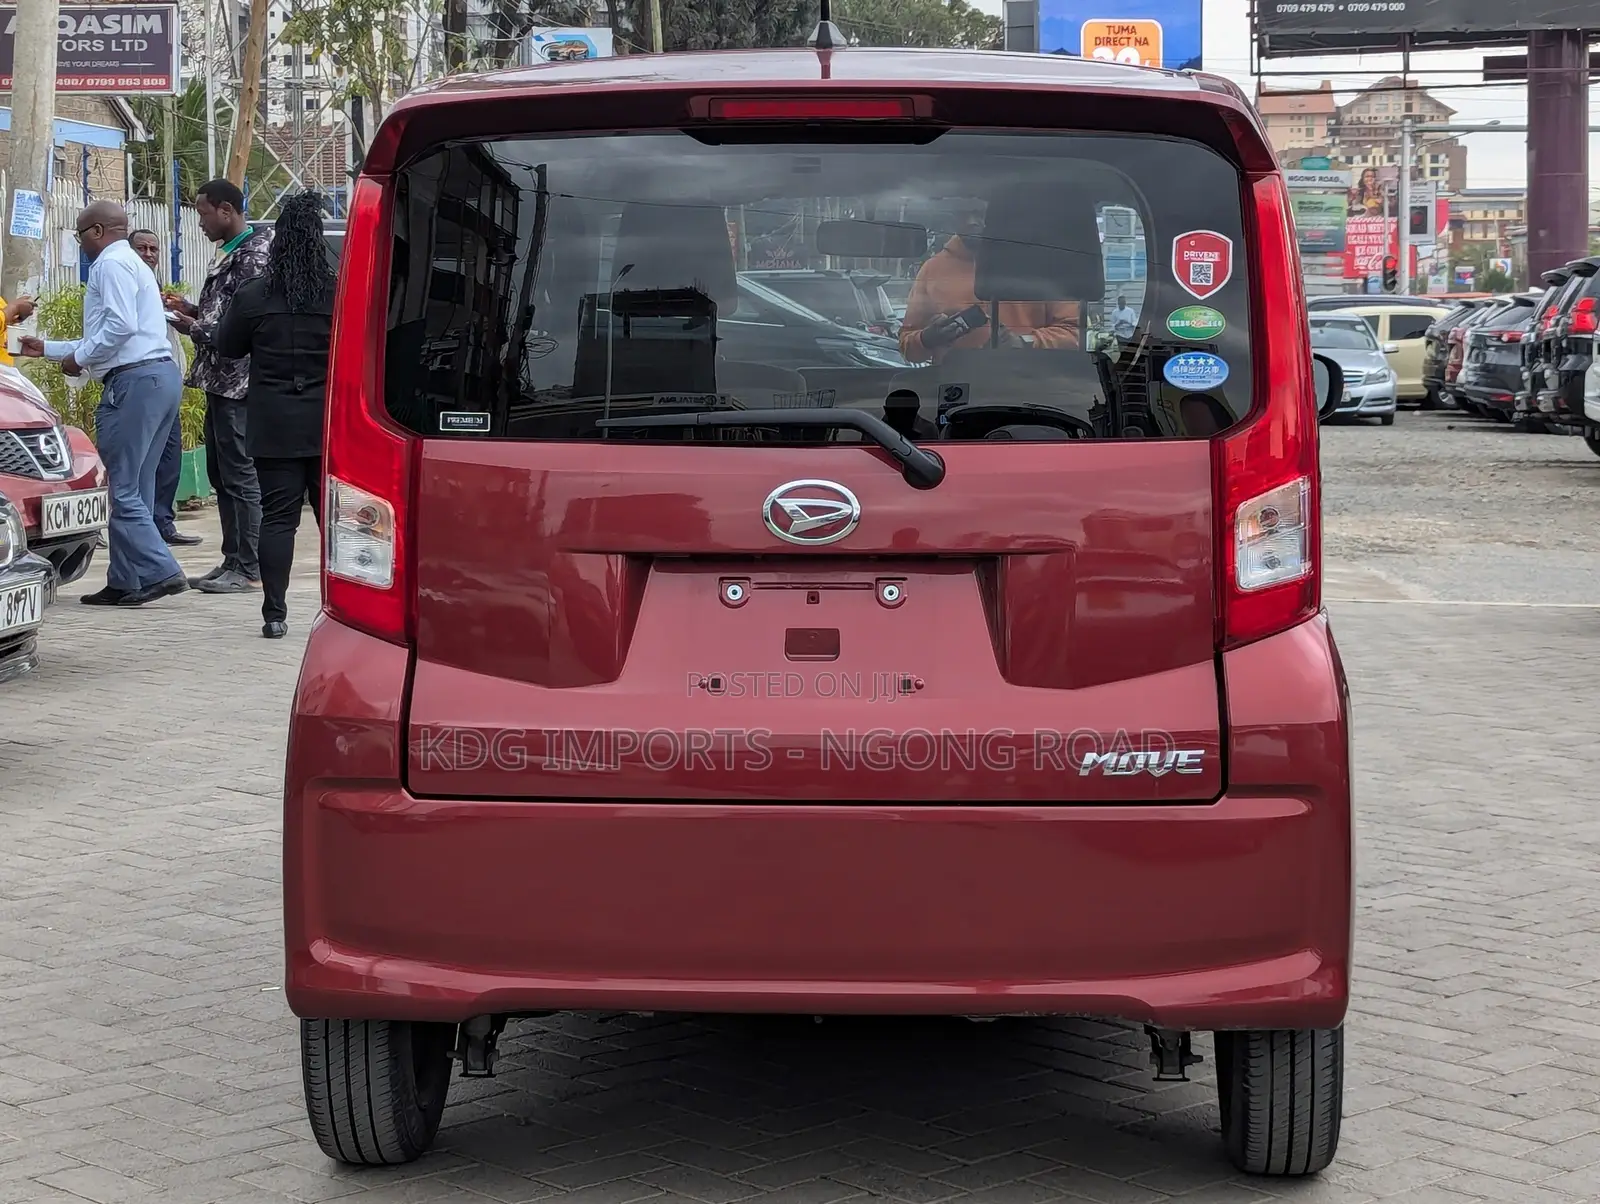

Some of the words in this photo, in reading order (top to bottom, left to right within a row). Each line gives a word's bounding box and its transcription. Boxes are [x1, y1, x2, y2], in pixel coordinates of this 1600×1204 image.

[1276, 4, 1298, 13] 0709
[1299, 3, 1316, 12] 479
[1317, 3, 1335, 12] 479
[1347, 3, 1369, 12] 0709
[1370, 3, 1387, 11] 479
[1388, 2, 1406, 11] 000
[1105, 25, 1137, 35] TUMA
[57, 39, 105, 52] TORS
[111, 39, 148, 52] LTD
[1094, 36, 1131, 46] DIRECT
[1134, 36, 1149, 46] NA
[45, 500, 71, 531] KCW
[1079, 749, 1205, 777] MOVE
